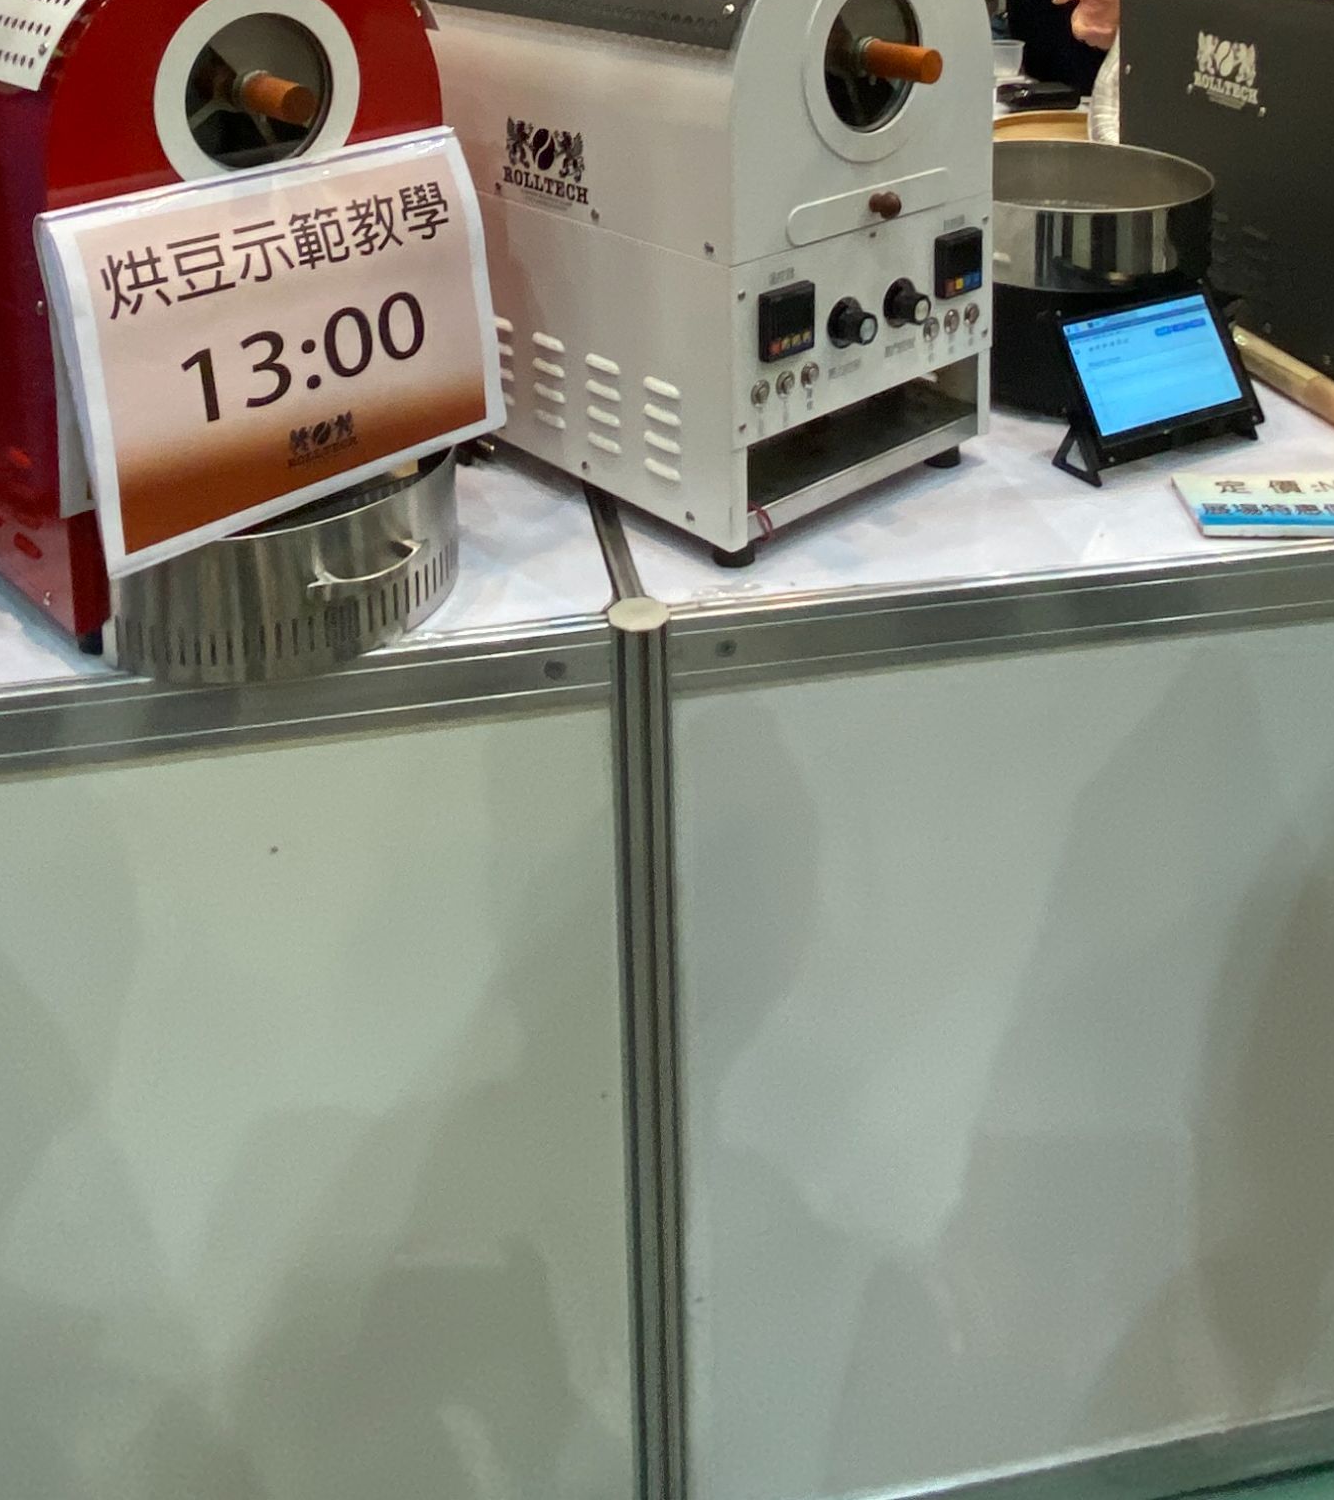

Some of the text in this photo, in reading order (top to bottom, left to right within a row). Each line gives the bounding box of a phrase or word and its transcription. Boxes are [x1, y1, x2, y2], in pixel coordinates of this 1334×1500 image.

[1193, 71, 1259, 105] ROLLTECH
[502, 166, 589, 205] ROLLTECH
[99, 180, 450, 320] 烘豆示範教學
[180, 291, 426, 423] 13:00
